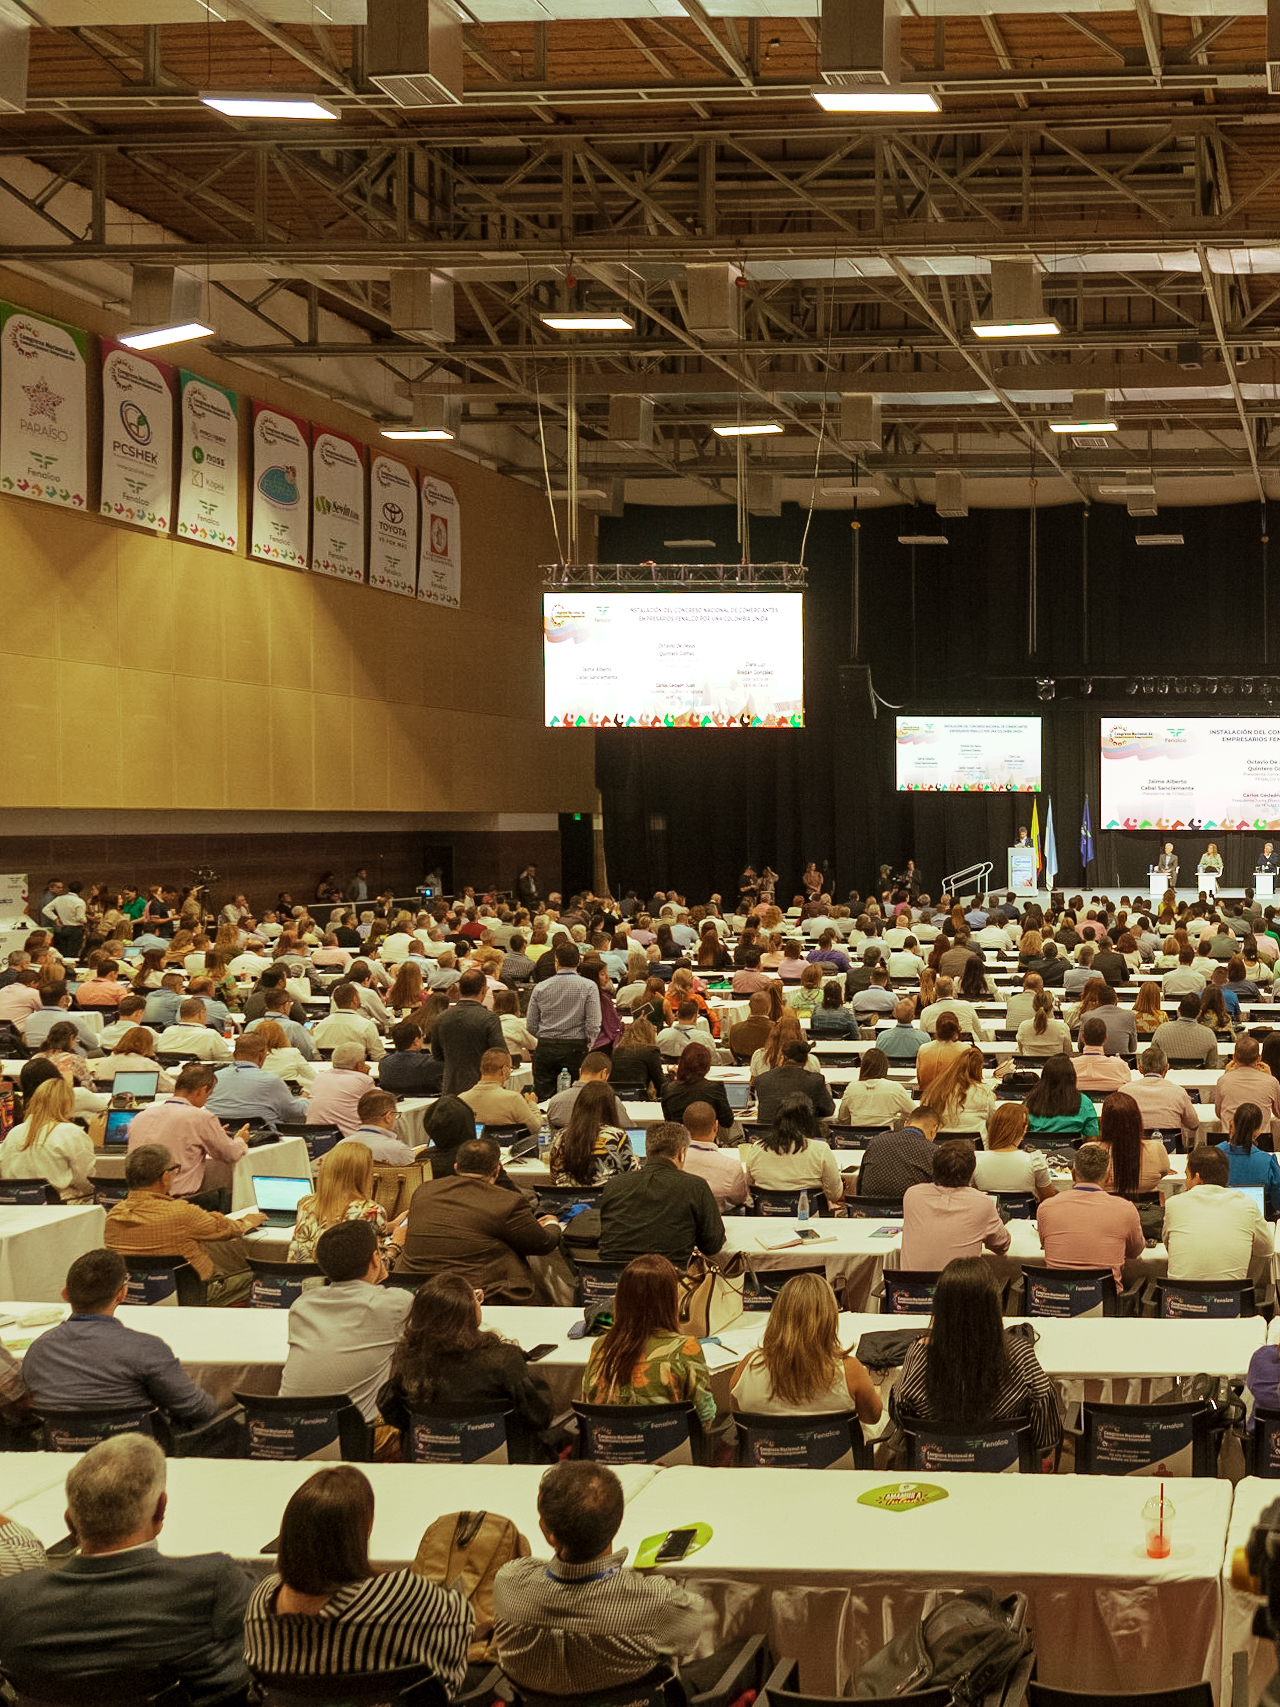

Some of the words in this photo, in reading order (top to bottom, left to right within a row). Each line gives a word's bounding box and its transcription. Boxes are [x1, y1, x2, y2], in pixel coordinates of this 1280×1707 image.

[112, 440, 158, 466] PCSHEK
[27, 467, 61, 484] Fenalco
[122, 491, 150, 507] Fenalco
[197, 513, 220, 527] Fenalco
[379, 520, 407, 537] TOYOTA
[109, 1420, 140, 1430] Fenalco
[300, 1417, 328, 1426] Fenalco
[467, 1422, 495, 1431] Fenalco
[650, 1420, 678, 1429] Fenalco
[1159, 1422, 1184, 1431] Fenalco
[813, 1429, 840, 1440] Fenalco
[982, 1437, 1009, 1448] Fenalco
